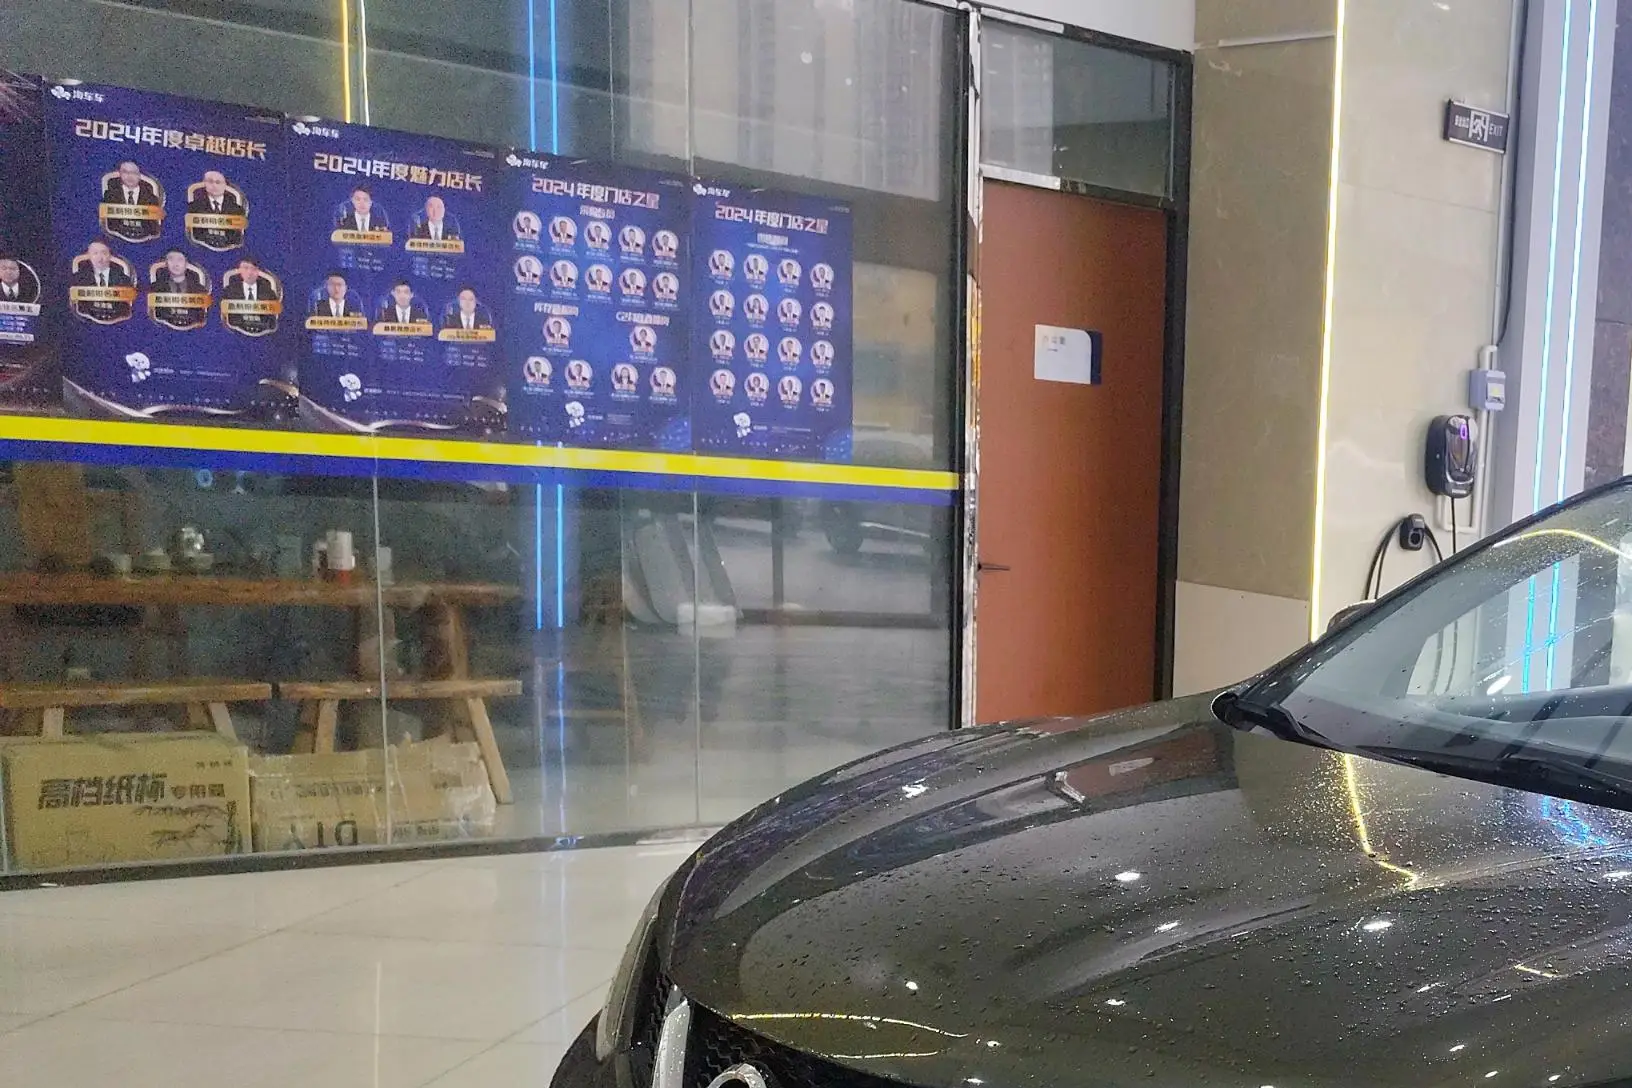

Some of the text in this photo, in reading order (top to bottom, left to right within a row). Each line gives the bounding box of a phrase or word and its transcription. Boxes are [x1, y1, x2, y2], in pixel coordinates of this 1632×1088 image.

[75, 118, 267, 160] 2024年度卓越店长
[1488, 123, 1504, 137] EXIT
[314, 152, 483, 192] 2024年度魅力店长
